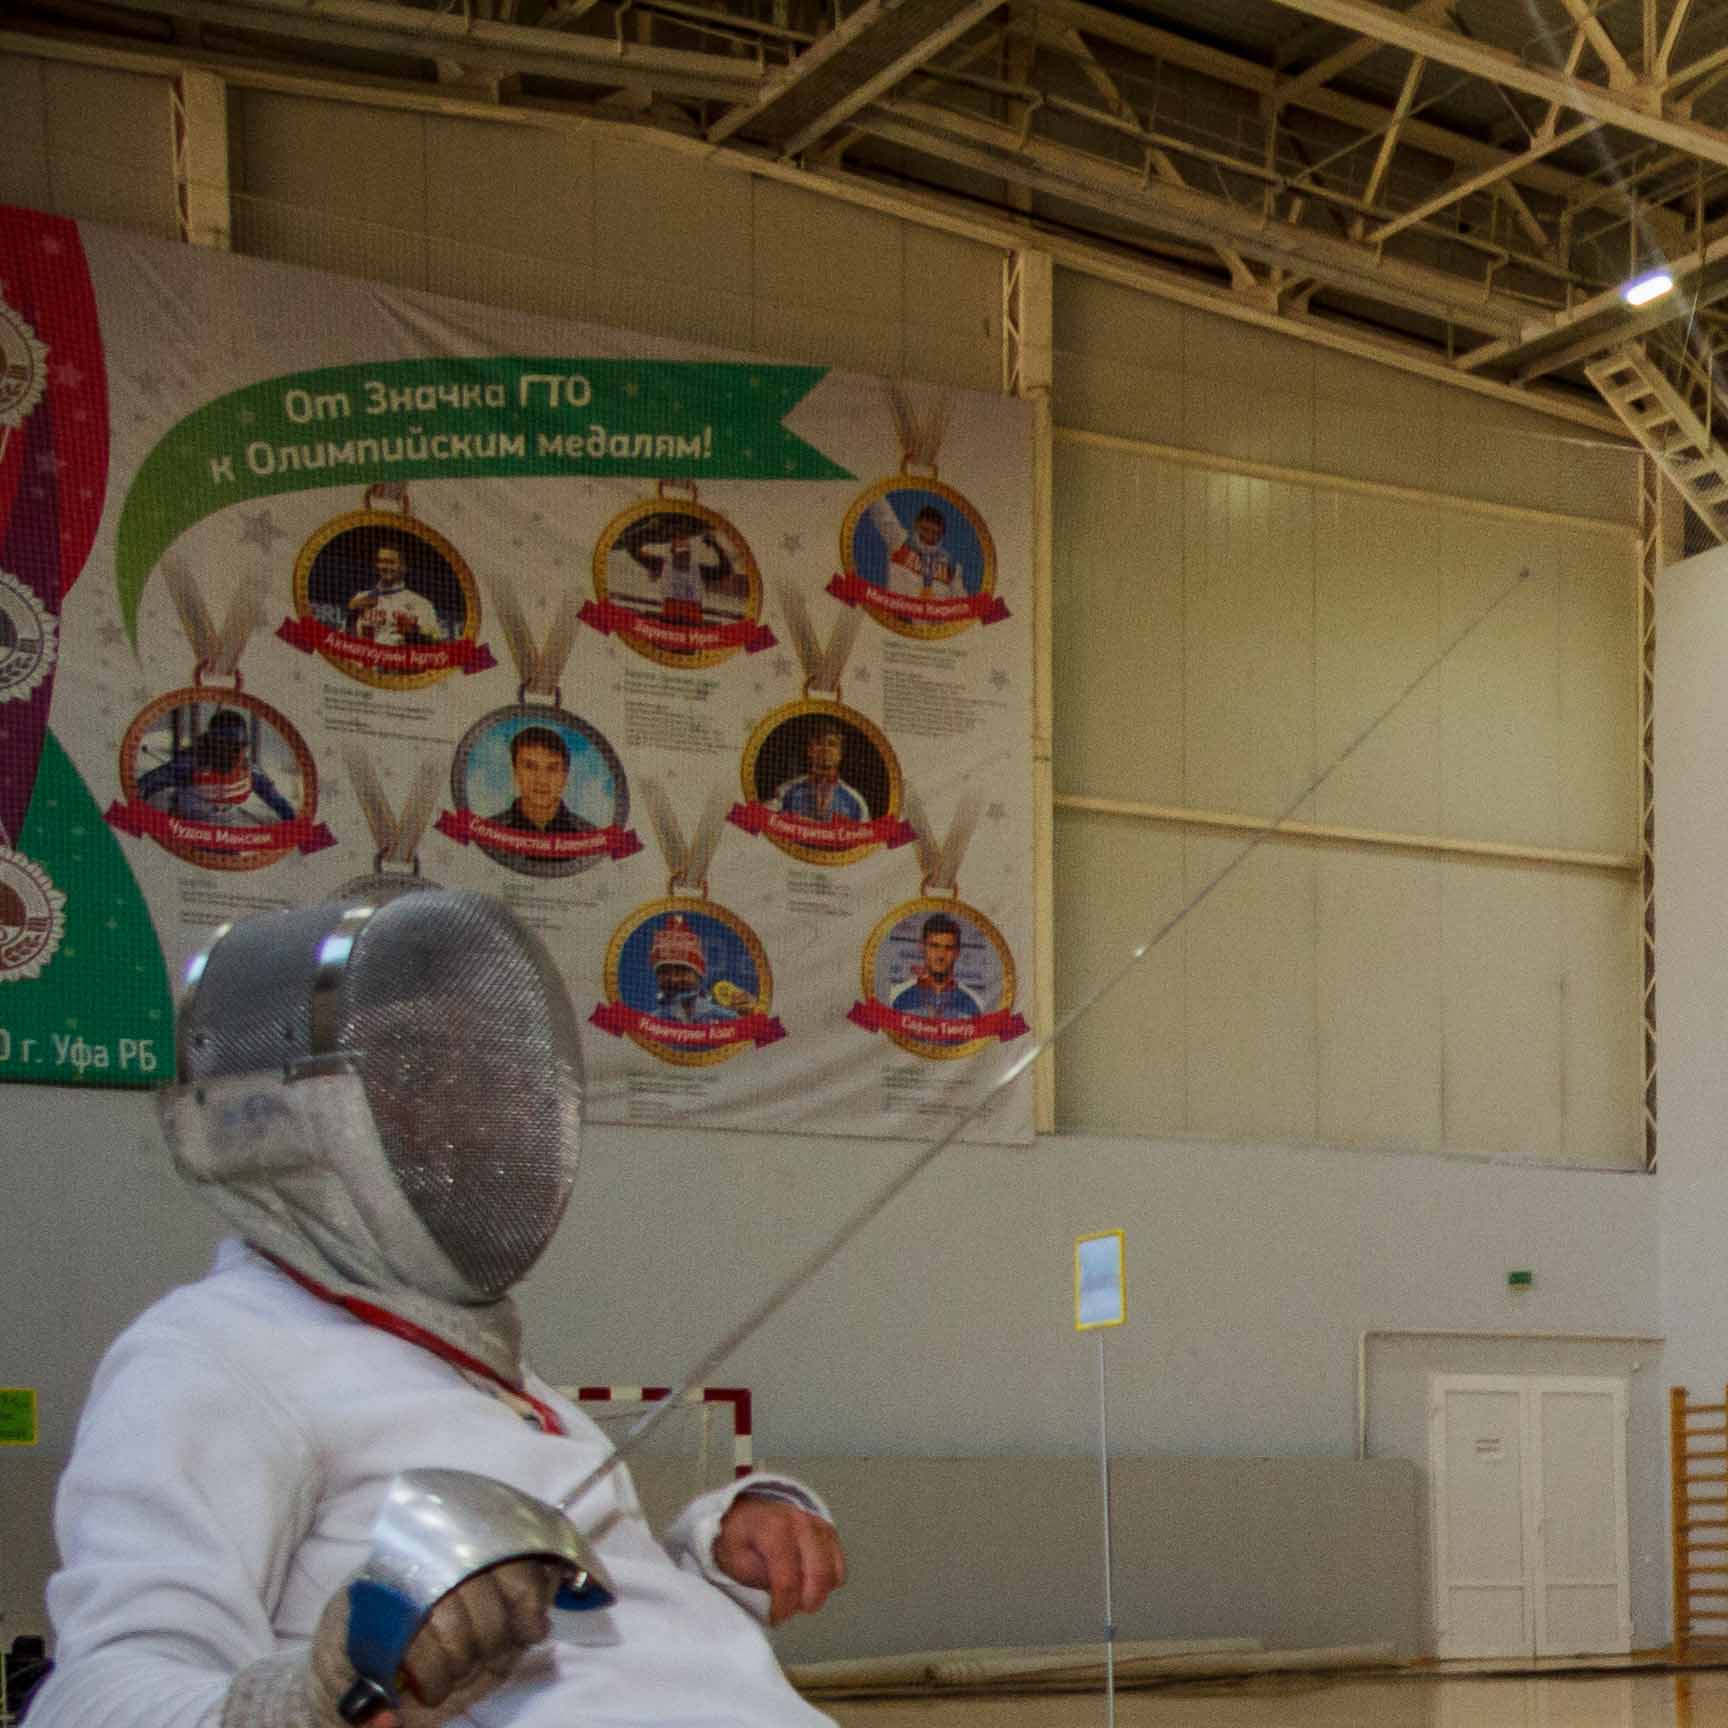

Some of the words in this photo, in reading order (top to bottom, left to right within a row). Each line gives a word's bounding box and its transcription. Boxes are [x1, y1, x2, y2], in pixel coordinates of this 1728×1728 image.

[285, 388, 350, 424] От
[364, 381, 507, 417] Значка
[519, 373, 593, 408] ГТО
[209, 454, 236, 485] к
[245, 426, 527, 476] Олимпийским
[536, 425, 715, 460] медалям!
[20, 1039, 44, 1064] г.
[51, 1033, 111, 1075] Уфа
[119, 1038, 158, 1073] РБ
